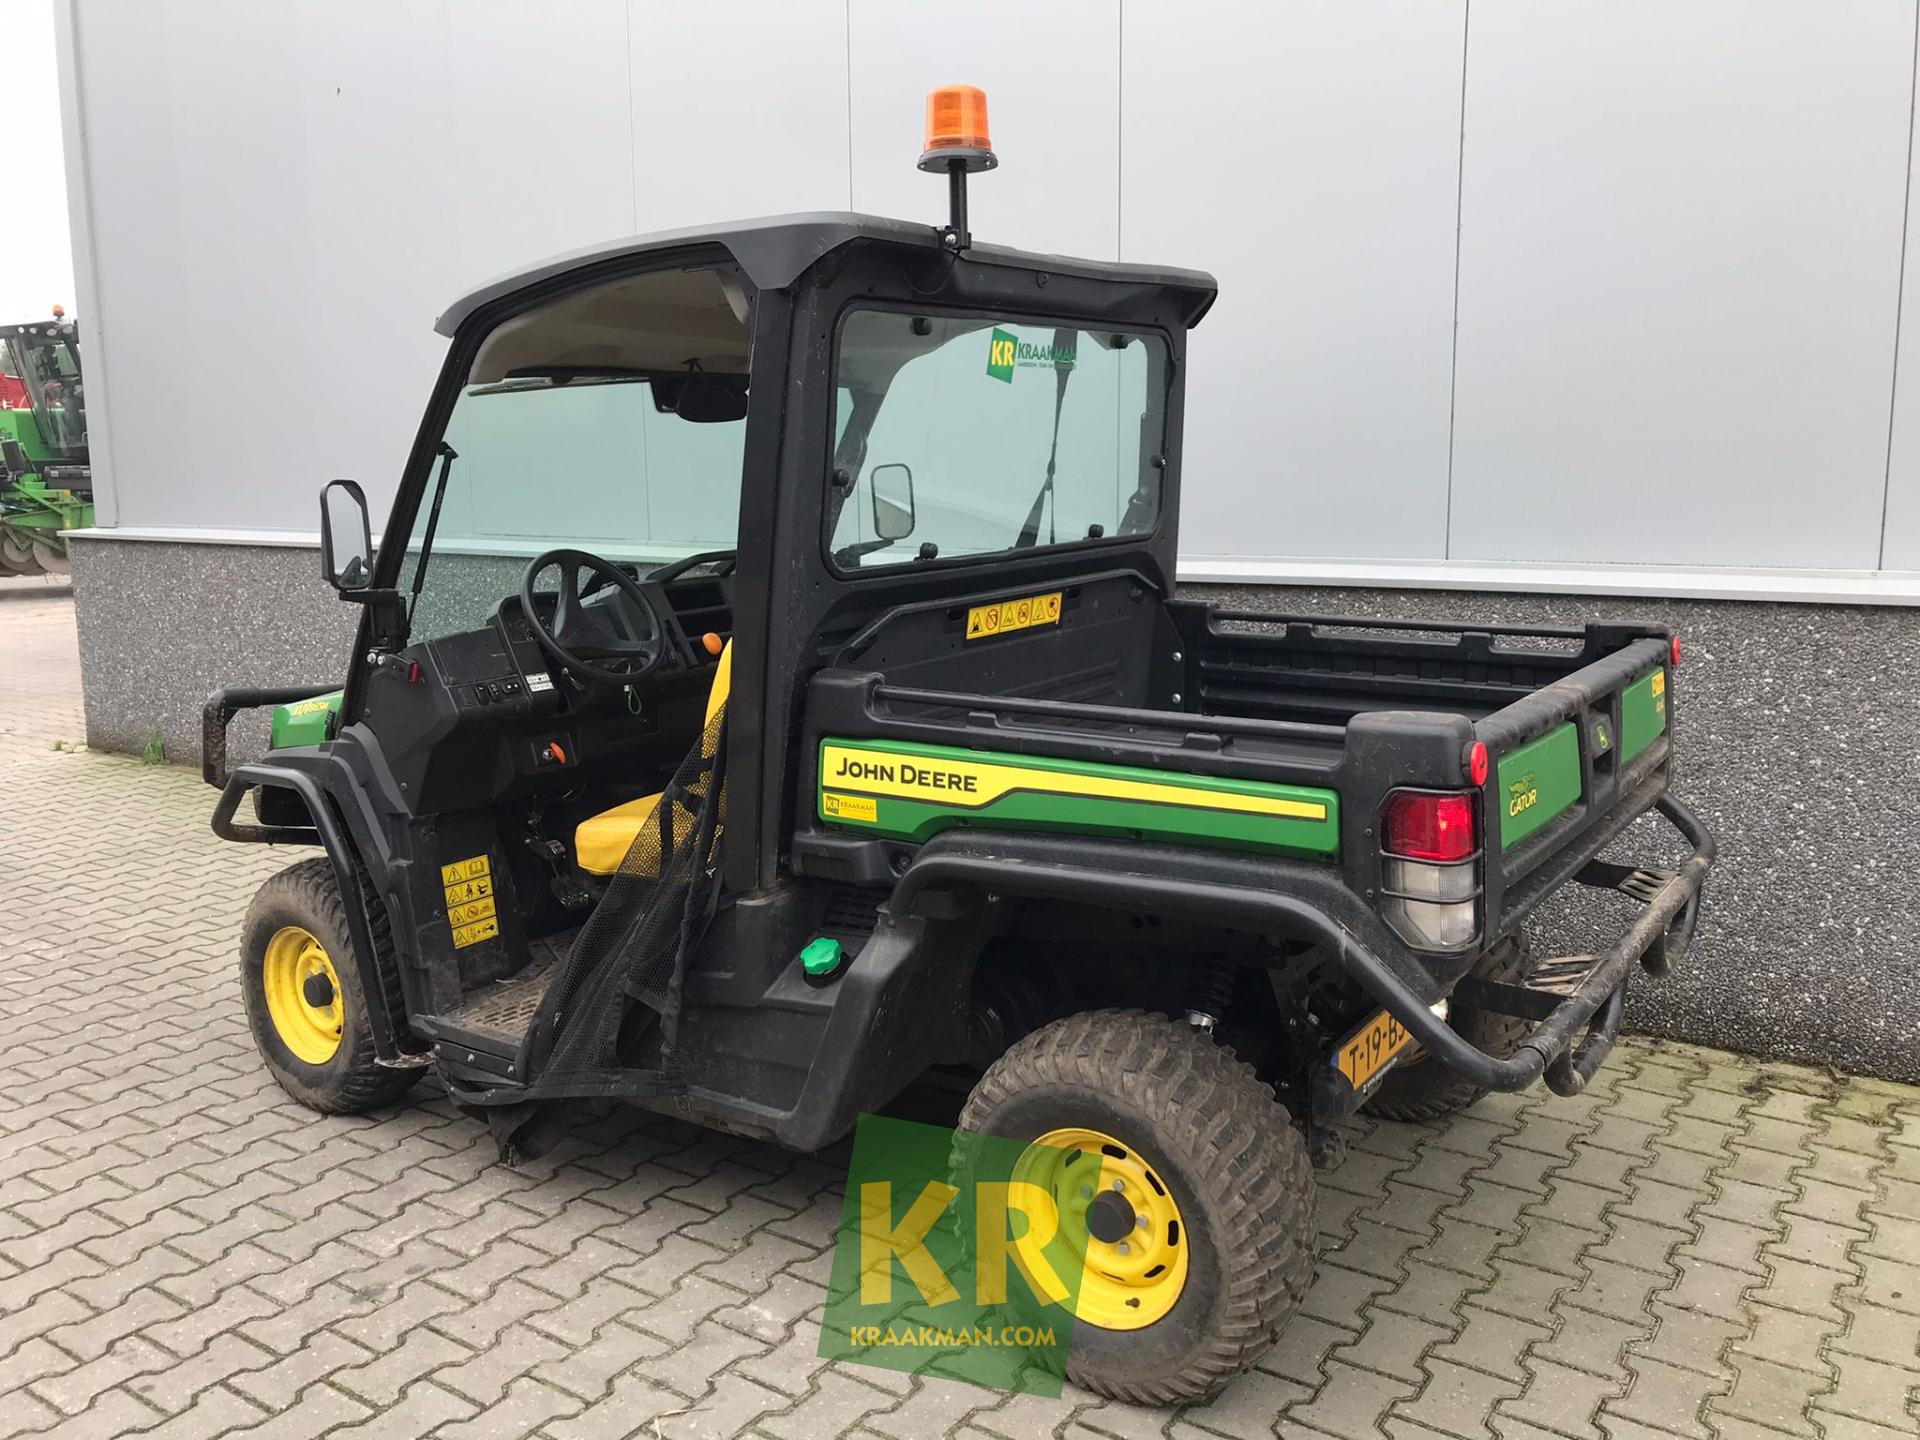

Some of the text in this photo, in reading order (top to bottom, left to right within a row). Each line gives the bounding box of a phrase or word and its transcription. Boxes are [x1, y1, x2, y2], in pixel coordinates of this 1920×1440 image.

[991, 340, 1014, 366] KR
[836, 757, 978, 793] JOHN DEERE
[827, 798, 839, 810] KR
[1509, 788, 1537, 817] GATOR
